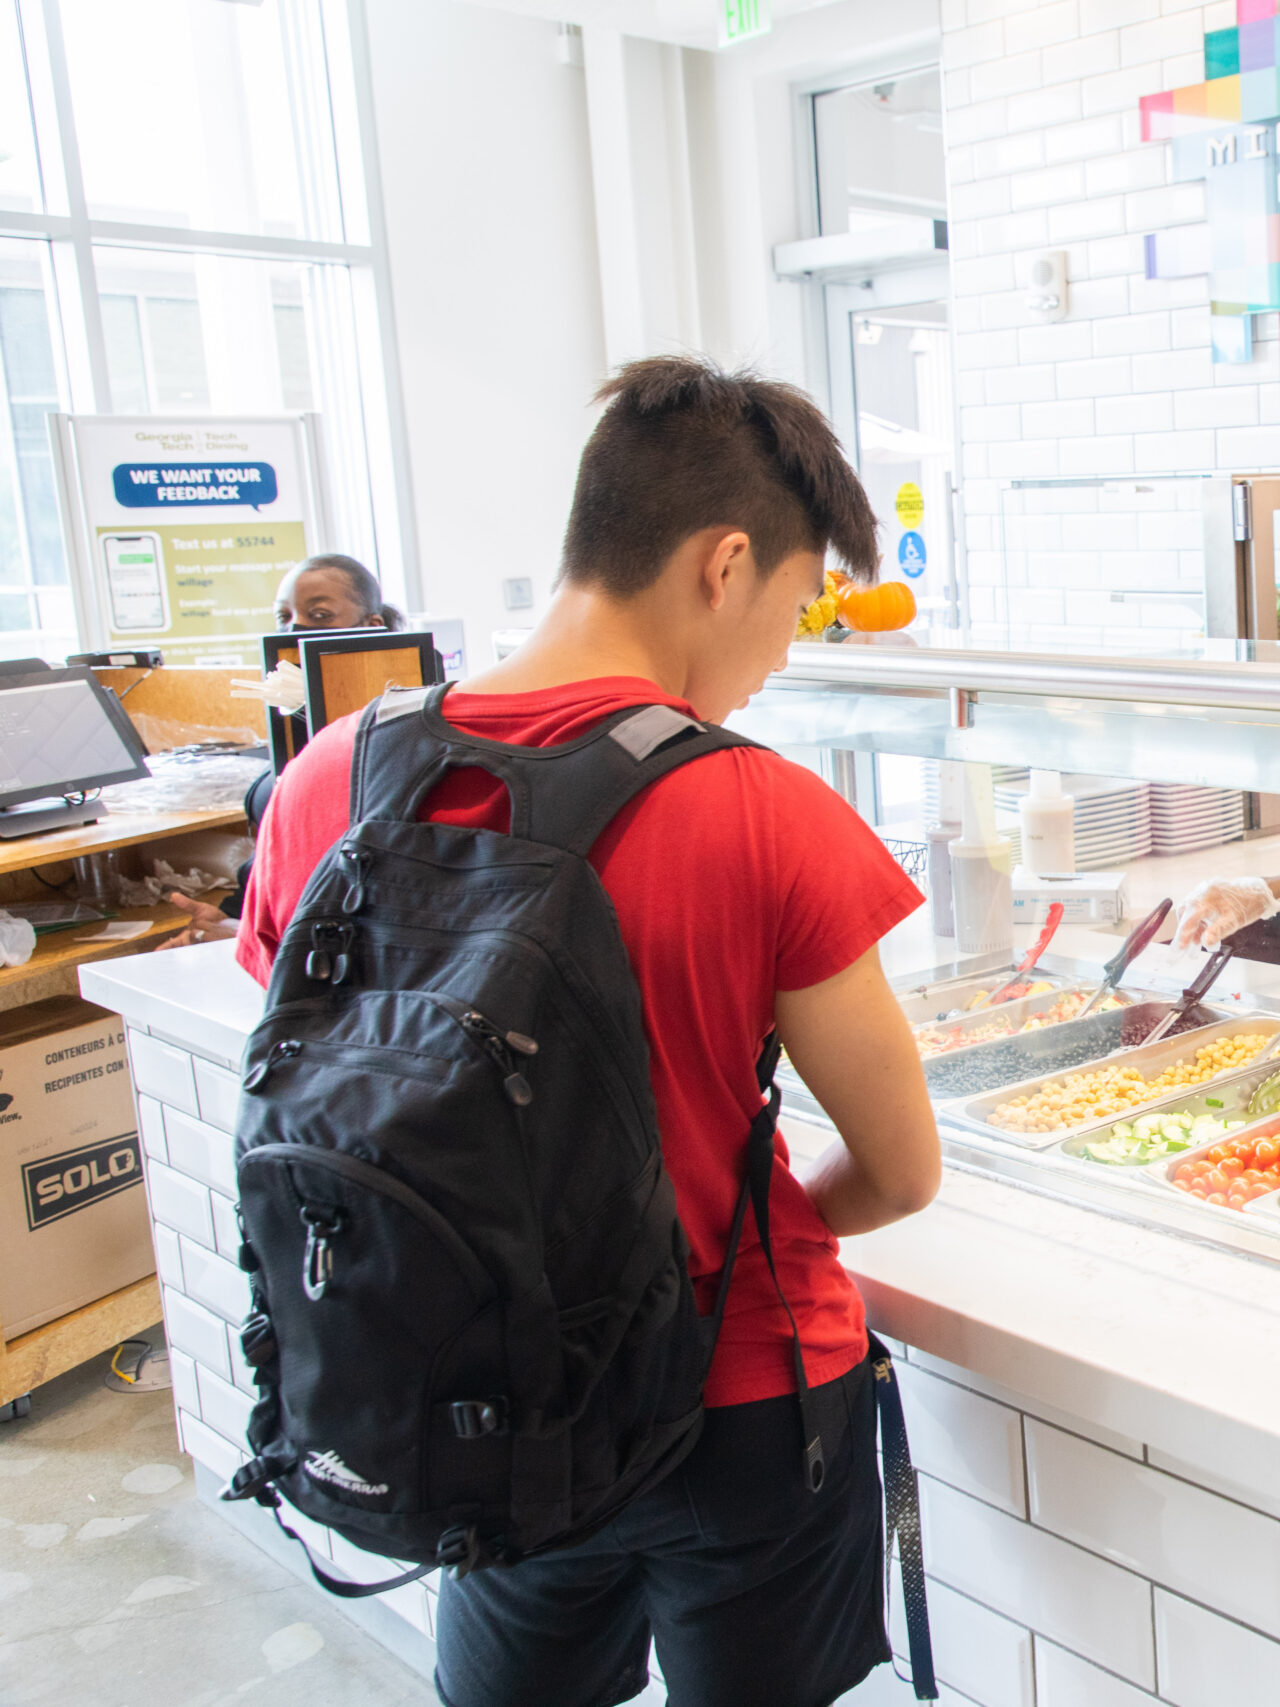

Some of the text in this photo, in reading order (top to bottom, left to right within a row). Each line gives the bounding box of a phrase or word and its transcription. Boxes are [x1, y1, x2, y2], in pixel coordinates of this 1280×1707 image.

[134, 431, 238, 442] Georgia Tech
[161, 441, 249, 451] Tech Dining
[129, 468, 262, 485] WE WANT YOUR
[157, 485, 241, 501] FEEDBACK
[172, 537, 200, 550] Text
[202, 539, 218, 549] us
[220, 537, 235, 549] at
[202, 564, 226, 575] your
[45, 1038, 105, 1066] CONTENEURS
[44, 1066, 104, 1094] RECIPIENTES
[105, 1060, 124, 1075] CON
[36, 1147, 136, 1206] SOLO
